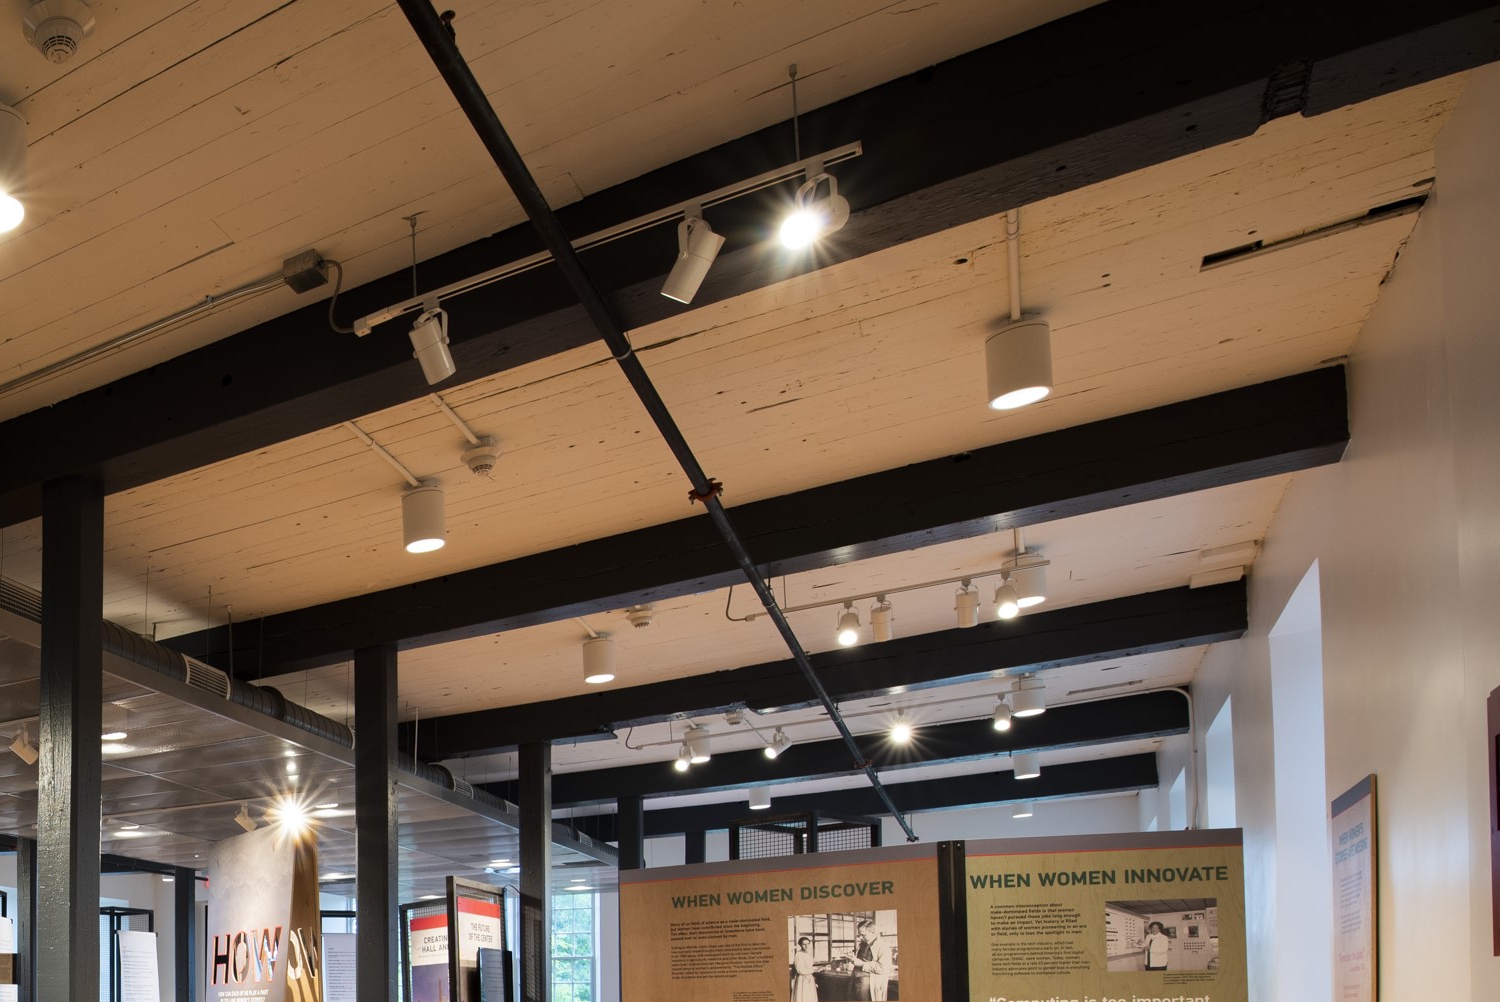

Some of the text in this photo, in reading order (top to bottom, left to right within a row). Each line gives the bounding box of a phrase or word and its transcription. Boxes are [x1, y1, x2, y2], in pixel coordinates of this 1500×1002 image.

[970, 866, 1228, 890] WHEN WOMEN INNOVATE
[671, 881, 894, 909] WHEN WOMEN DISCOVER
[422, 945, 436, 953] HALL
[424, 935, 448, 944] CREATIN
[211, 926, 282, 985] HOW
